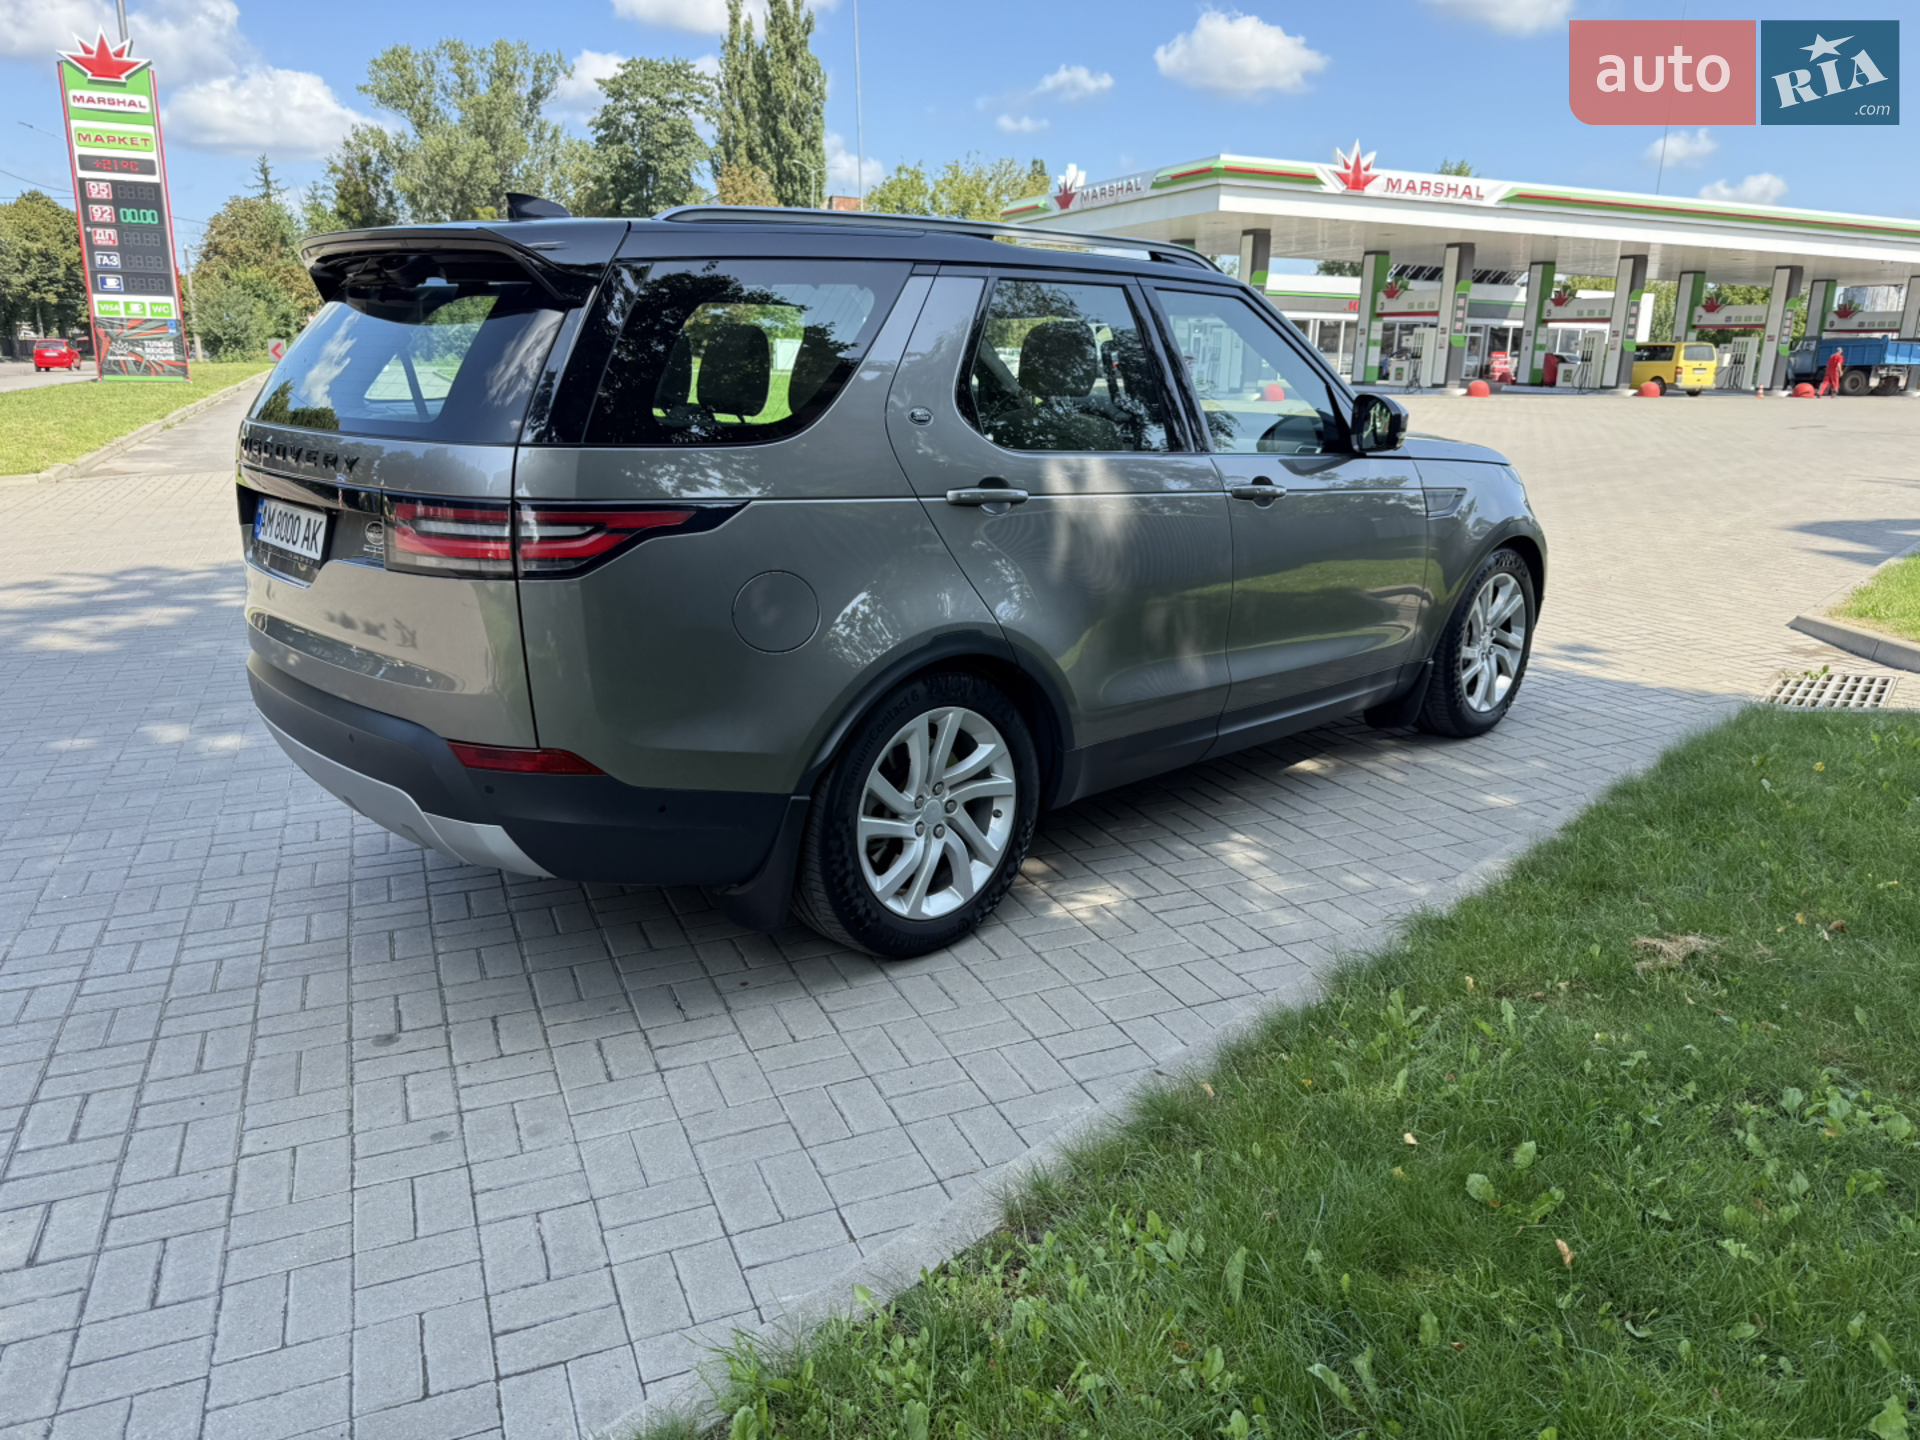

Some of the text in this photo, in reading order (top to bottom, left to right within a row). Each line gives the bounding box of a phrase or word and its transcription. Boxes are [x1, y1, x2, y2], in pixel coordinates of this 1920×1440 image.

[72, 94, 147, 110] MARSHAL
[77, 132, 150, 147] МАРКЕТ
[89, 183, 108, 196] 95
[1080, 178, 1142, 204] MARSHAL
[1386, 178, 1485, 202] MARSHAL
[92, 206, 159, 224] 92 00.00
[95, 230, 115, 241] ДП
[97, 255, 118, 266] ГАЗ
[98, 304, 120, 312] VISA
[152, 306, 170, 314] WC
[1379, 302, 1385, 311] 3
[1546, 309, 1552, 318] 5
[260, 504, 276, 541] AM
[274, 510, 302, 546] 8000
[301, 518, 324, 554] AK
[910, 689, 920, 702] 6
